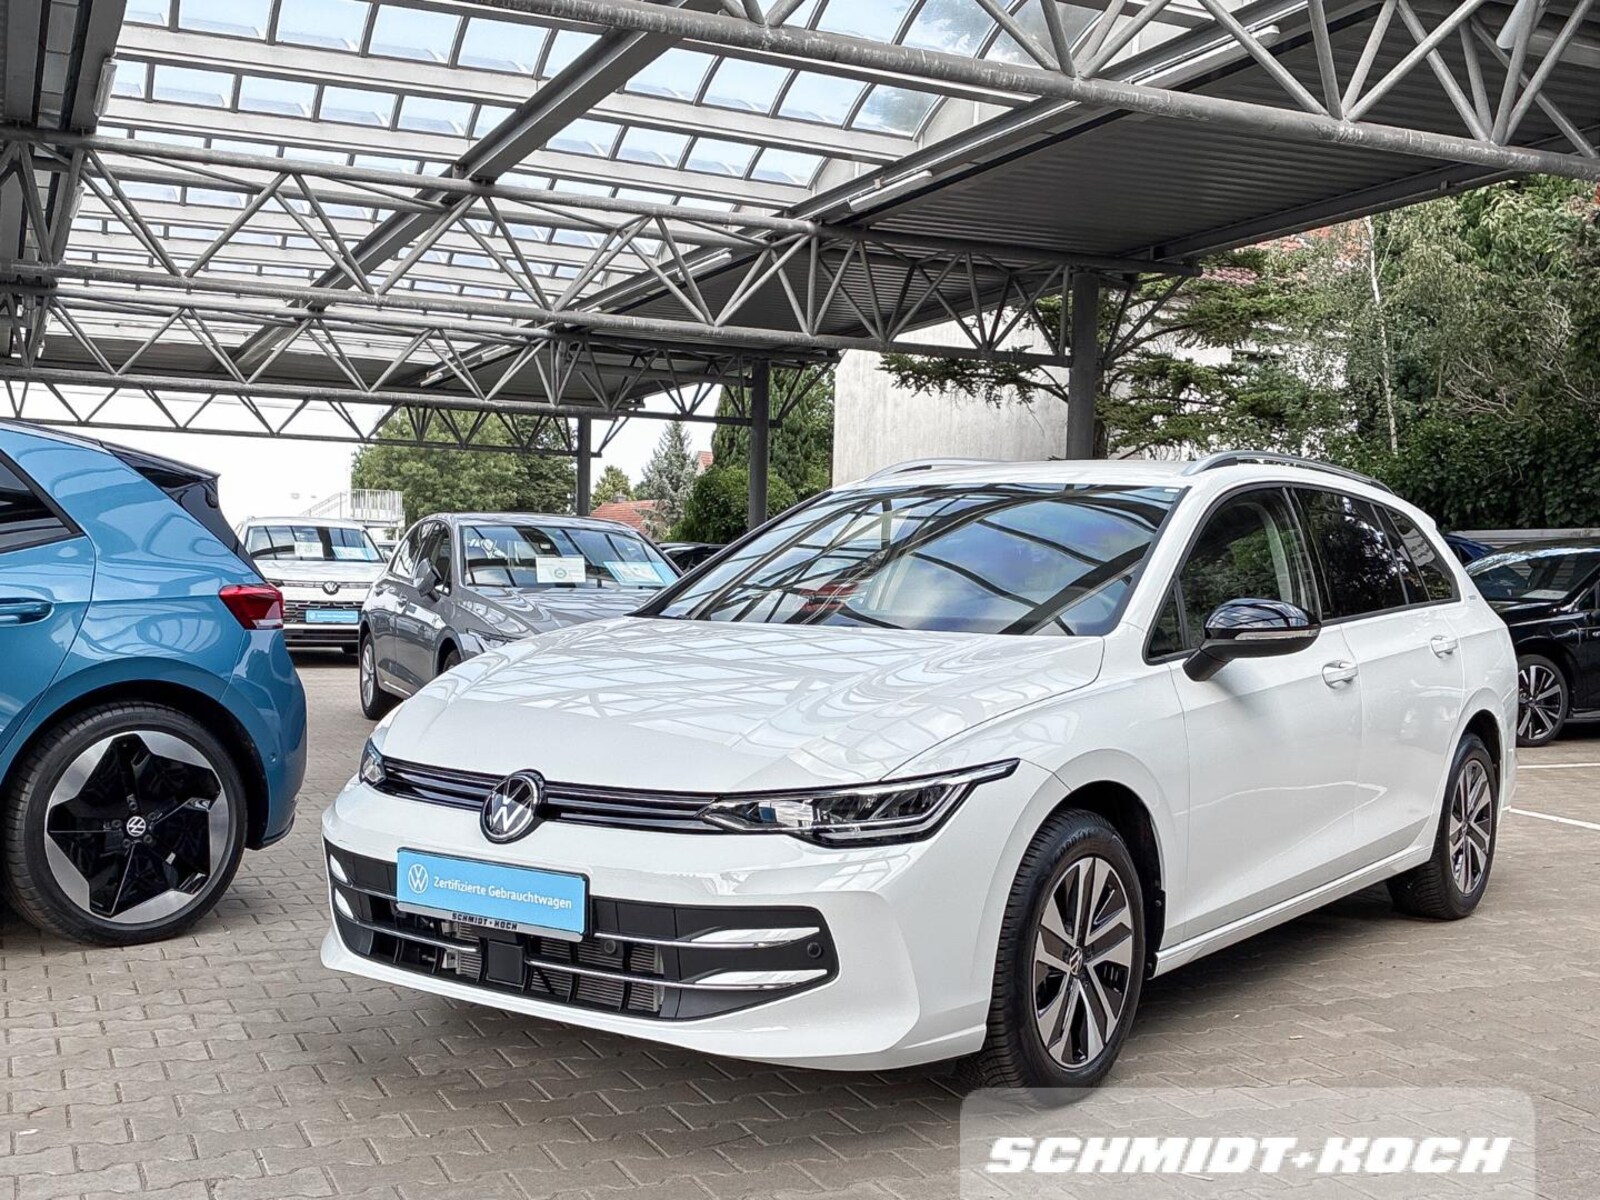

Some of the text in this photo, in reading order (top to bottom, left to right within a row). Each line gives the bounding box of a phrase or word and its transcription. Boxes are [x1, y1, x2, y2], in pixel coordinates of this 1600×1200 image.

[482, 774, 538, 840] VW
[408, 864, 428, 893] VW
[433, 875, 572, 910] Zertifizierte Gebrauchtwagen
